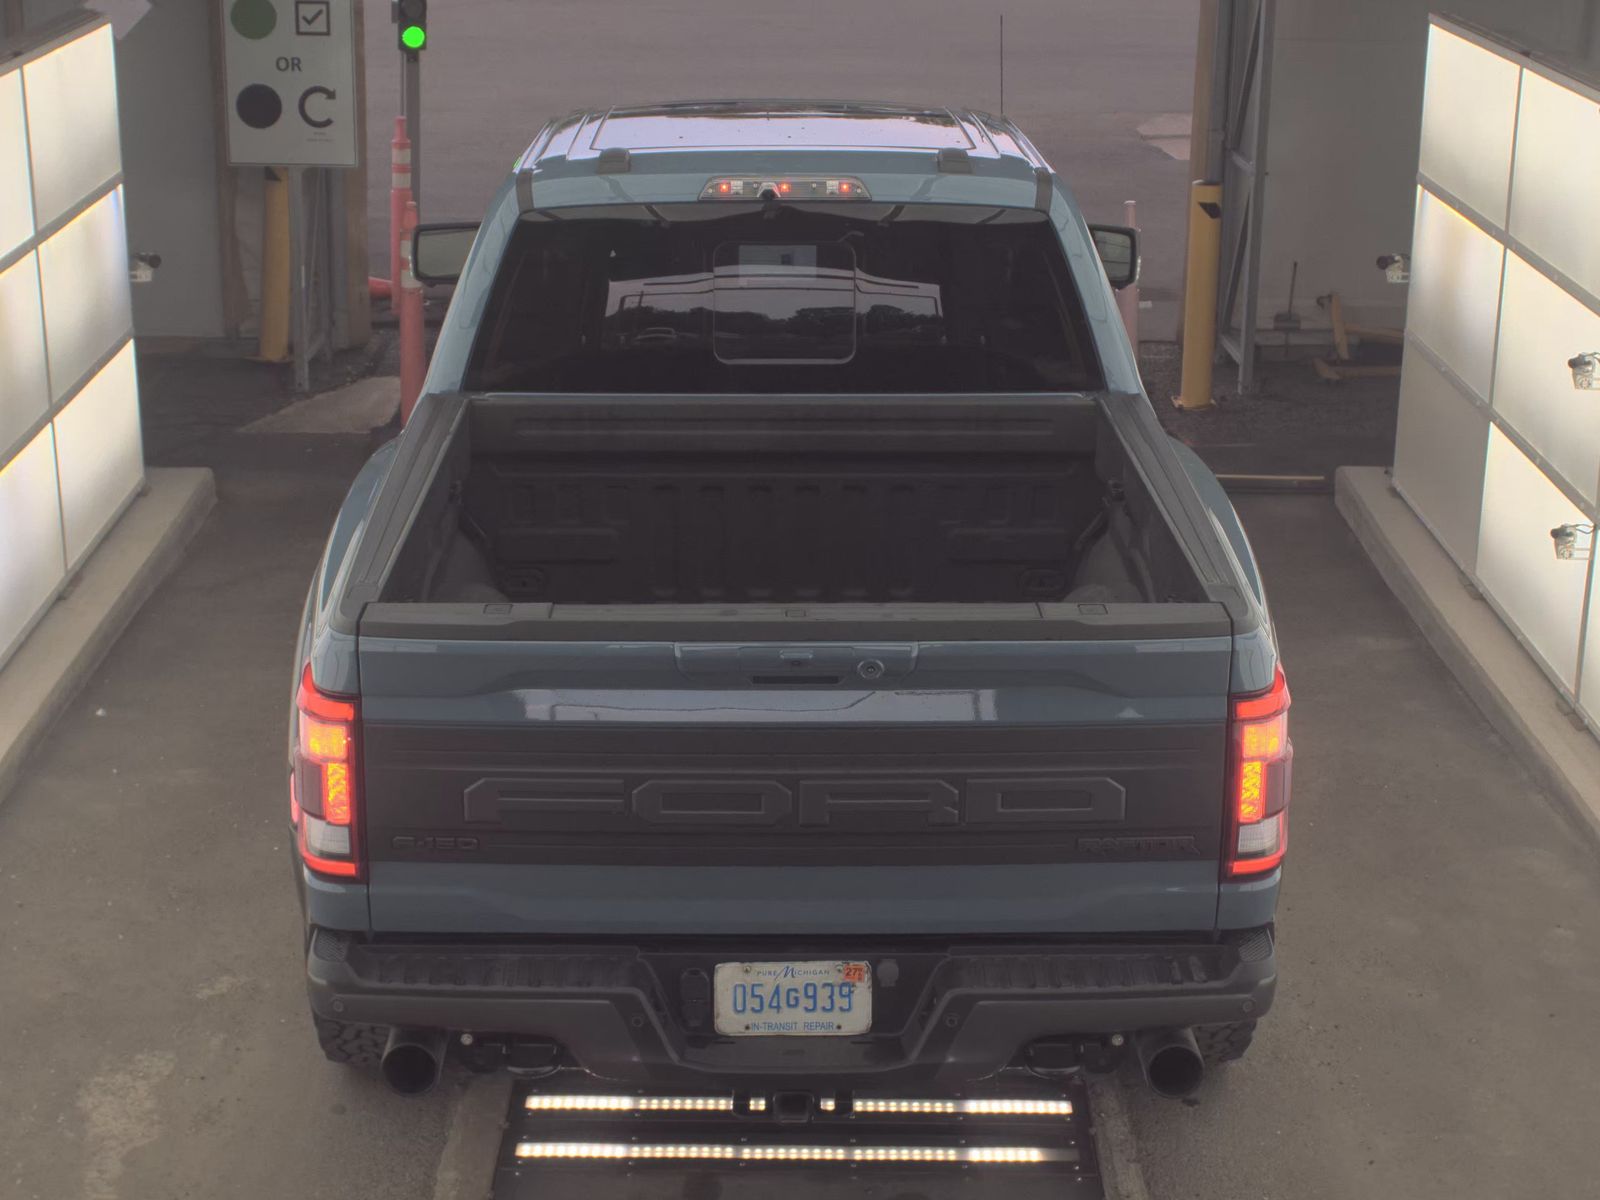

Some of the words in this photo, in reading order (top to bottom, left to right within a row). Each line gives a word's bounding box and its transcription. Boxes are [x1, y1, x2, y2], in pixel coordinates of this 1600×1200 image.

[275, 56, 302, 72] OR
[464, 777, 1127, 826] FORD
[845, 967, 857, 977] 27
[733, 982, 854, 1014] 054G939
[751, 1021, 798, 1031] IN-TRANSIT
[803, 1021, 834, 1031] REPAIR
